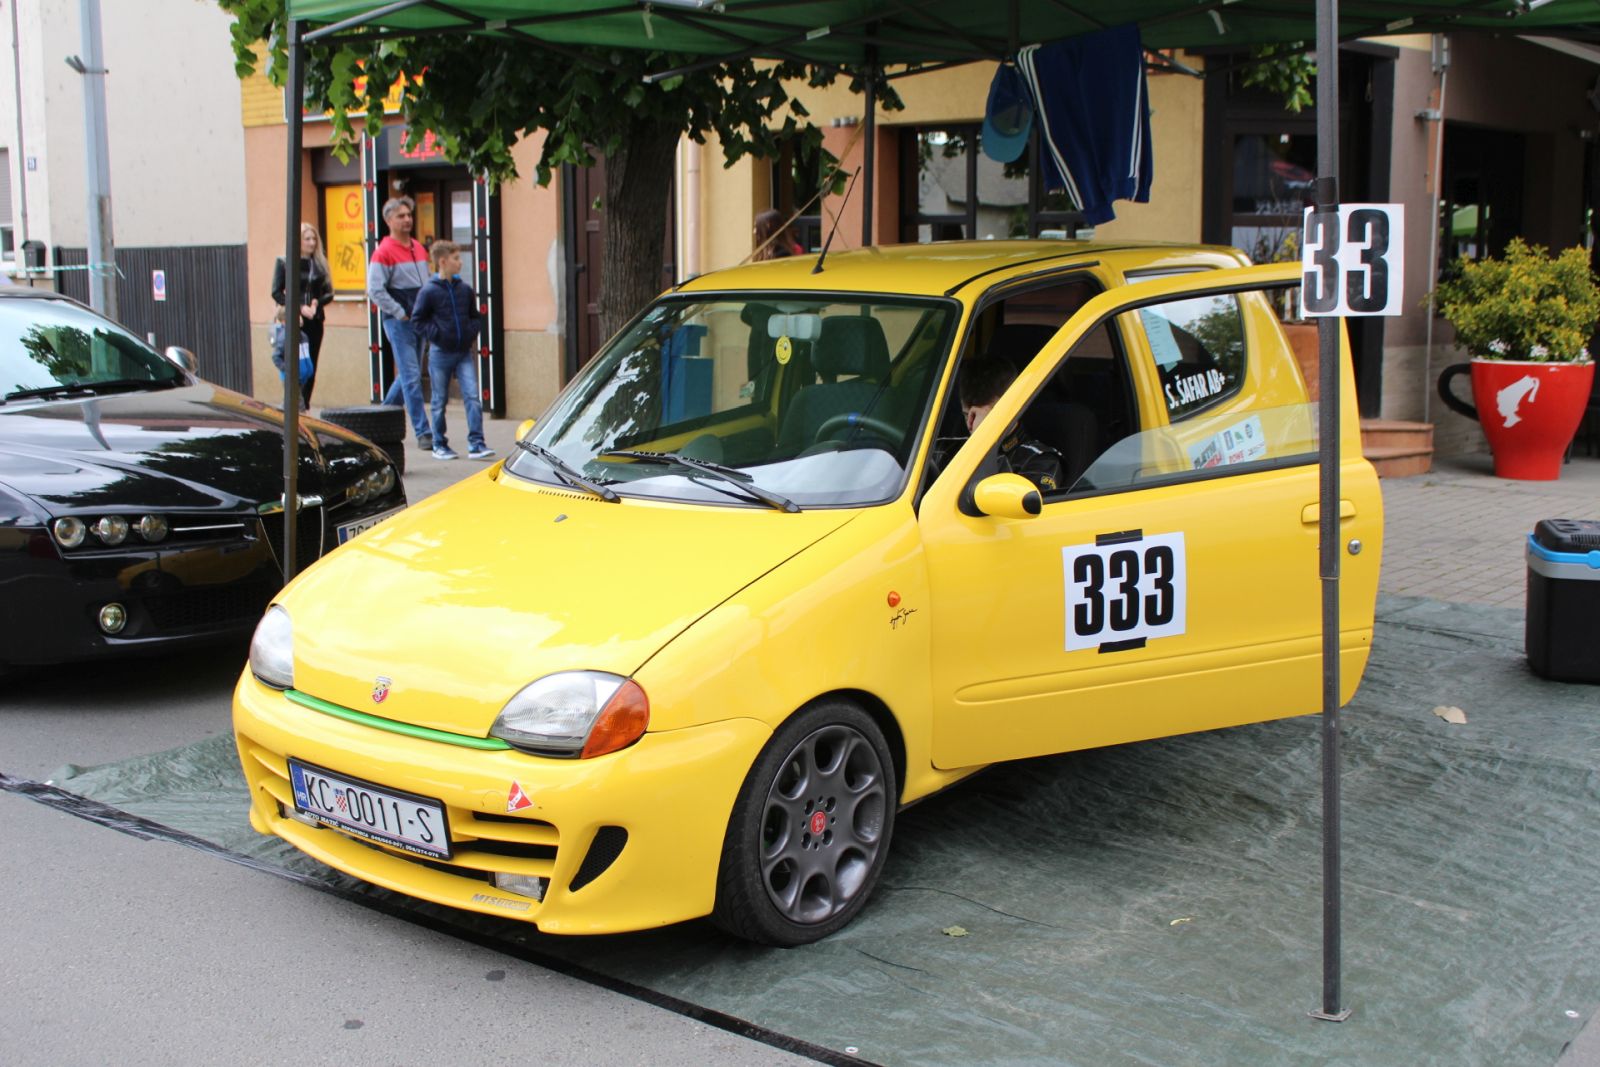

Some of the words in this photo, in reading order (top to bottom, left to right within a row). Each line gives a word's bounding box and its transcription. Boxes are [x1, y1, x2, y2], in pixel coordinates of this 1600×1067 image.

[1303, 209, 1390, 313] 33
[1165, 383, 1179, 409] S.
[1174, 373, 1209, 405] ŠAFAR
[1206, 368, 1226, 395] AB+
[1073, 545, 1175, 637] 333
[305, 774, 334, 813] KC
[346, 787, 433, 843] 0011-S
